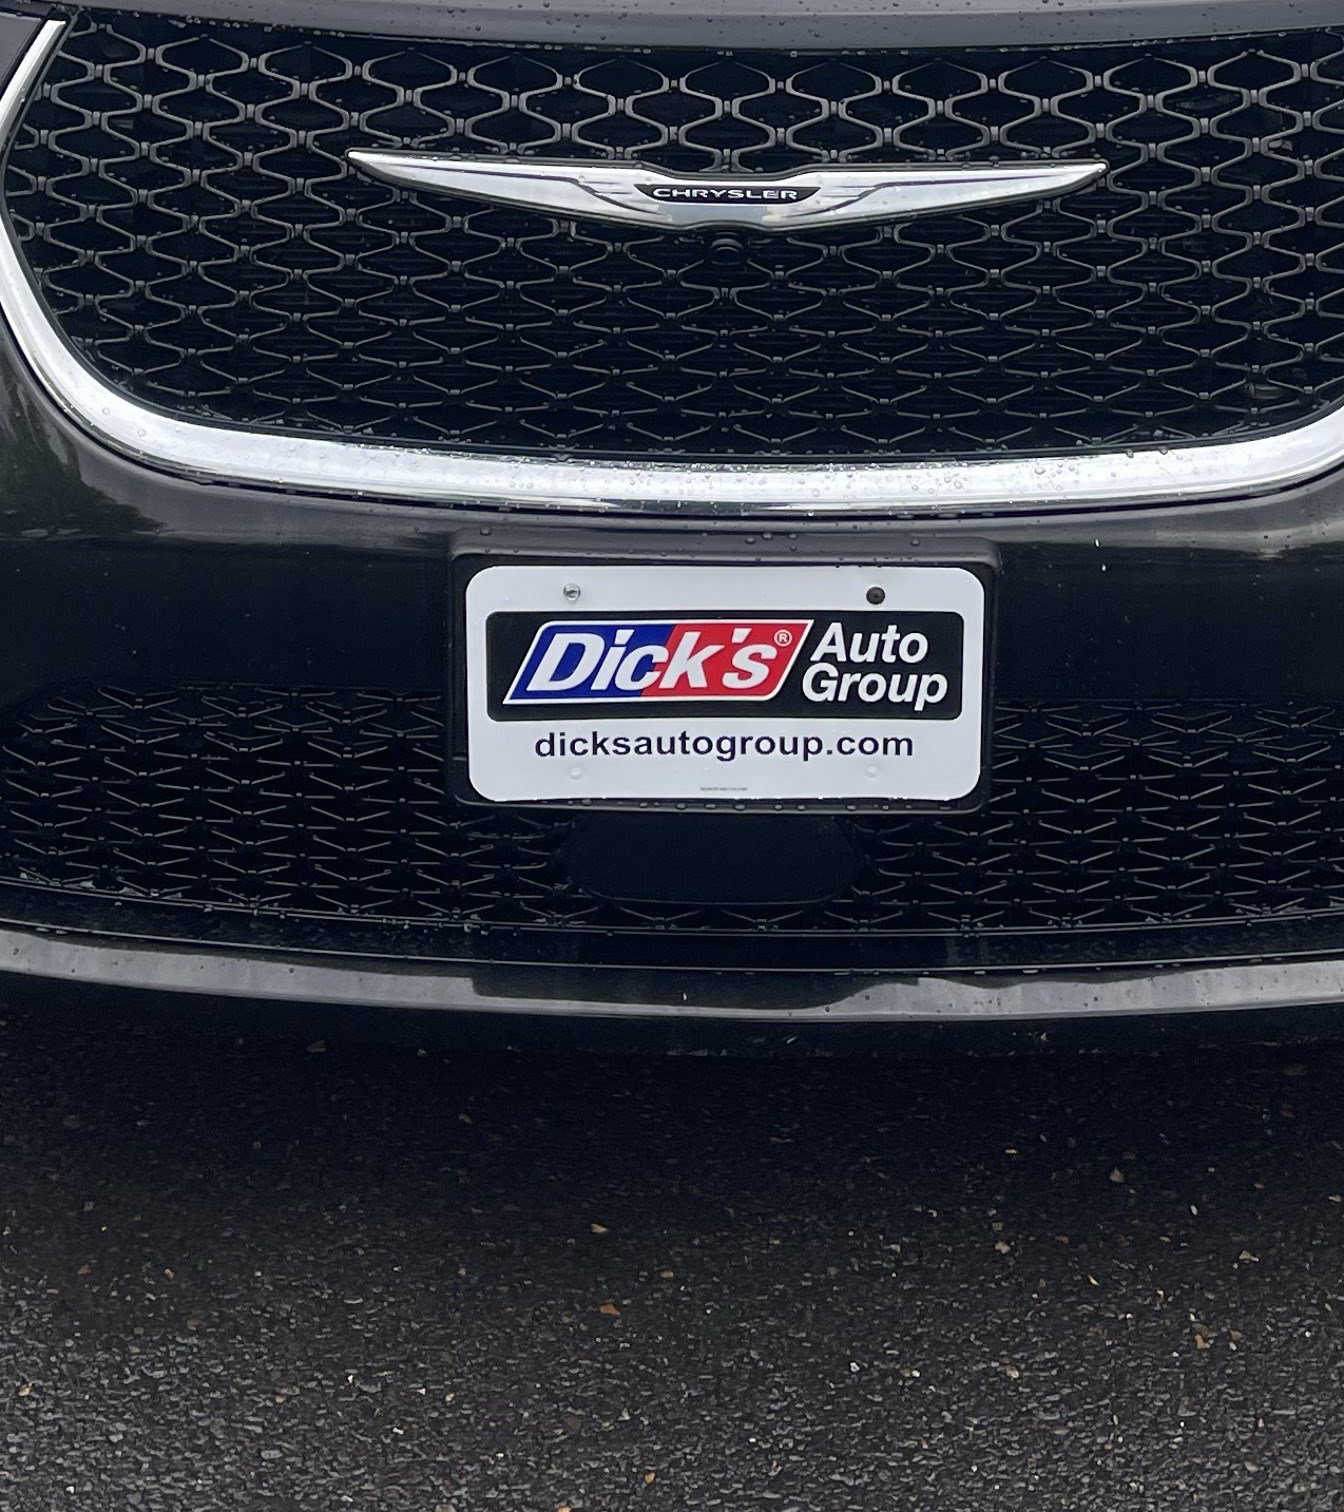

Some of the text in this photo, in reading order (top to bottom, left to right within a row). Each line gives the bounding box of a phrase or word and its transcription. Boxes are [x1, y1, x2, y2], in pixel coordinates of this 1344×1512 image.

[652, 188, 798, 200] CHRYSLER
[810, 623, 929, 664] Auto
[802, 663, 948, 712] Group
[535, 731, 914, 762] dicksautogroup.com
